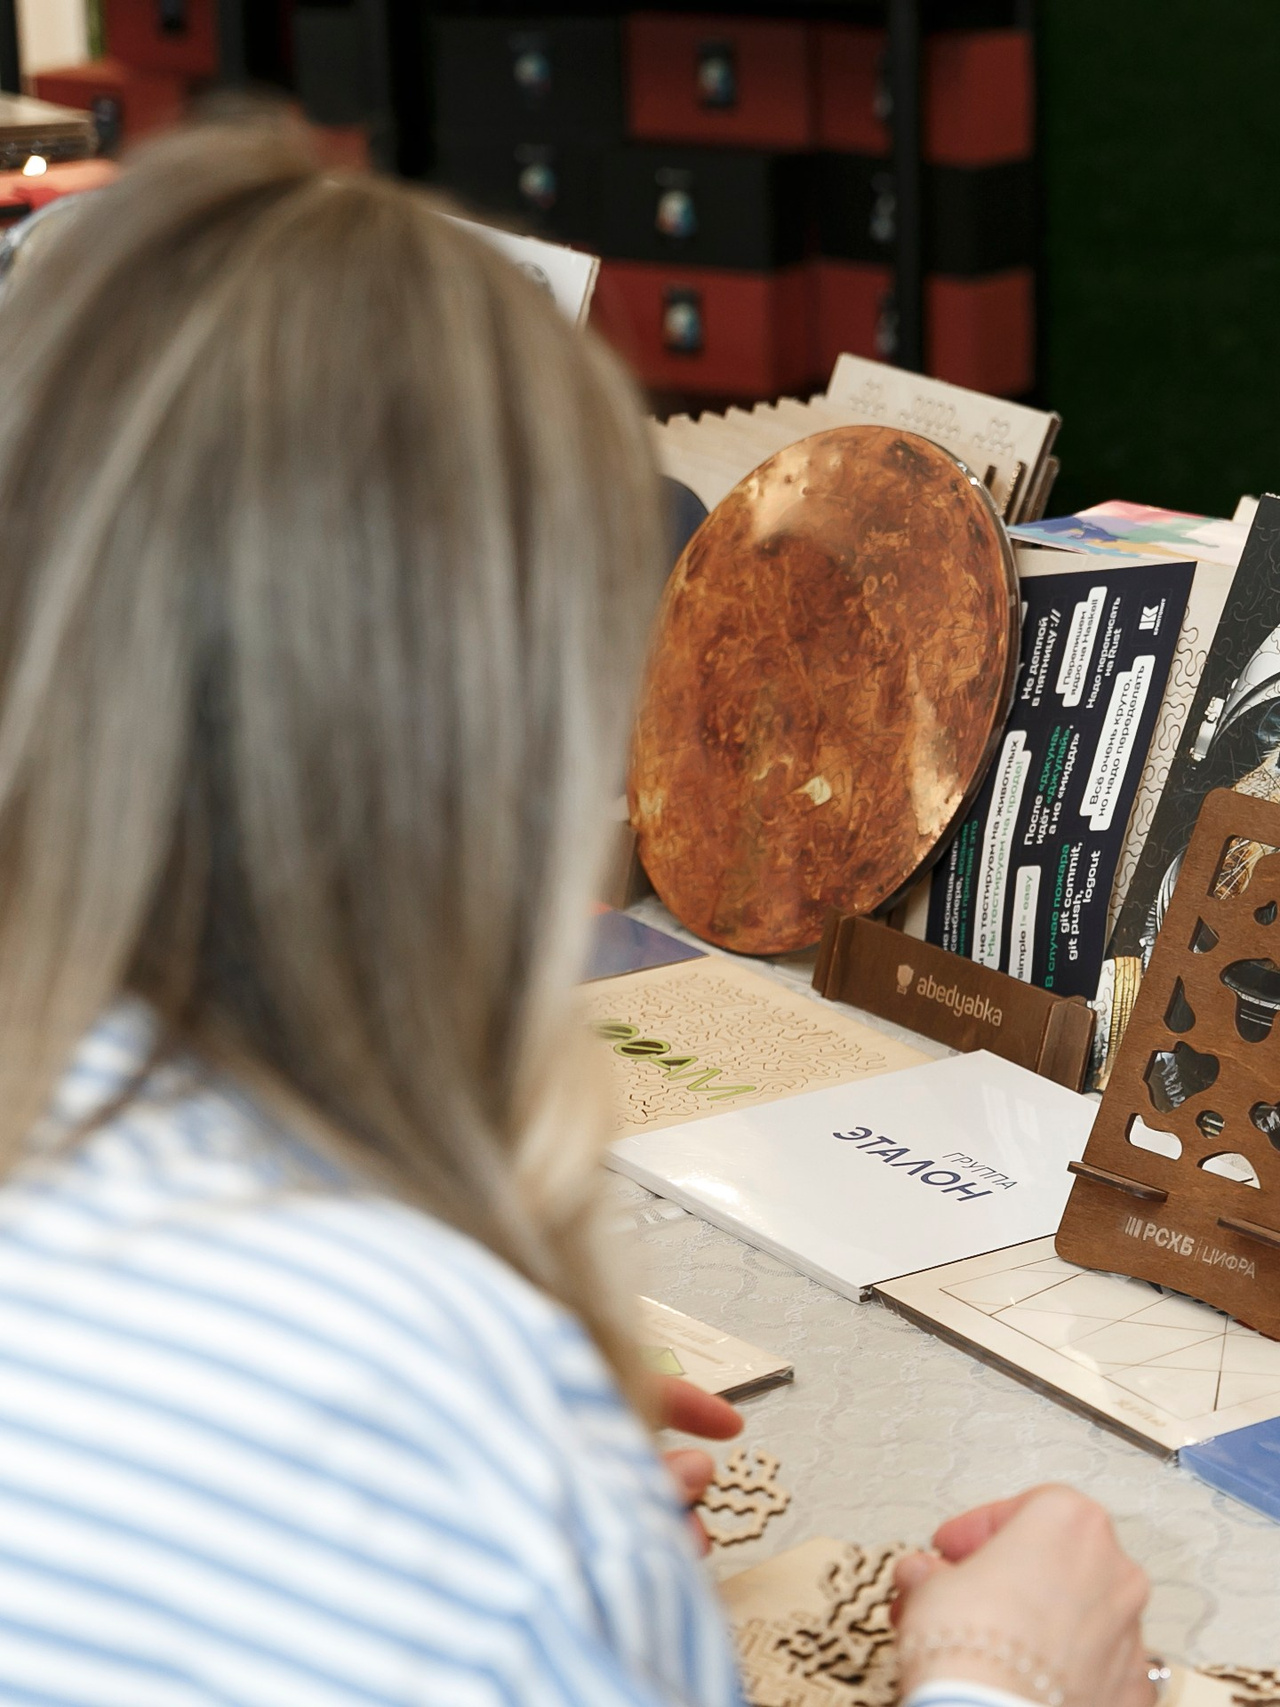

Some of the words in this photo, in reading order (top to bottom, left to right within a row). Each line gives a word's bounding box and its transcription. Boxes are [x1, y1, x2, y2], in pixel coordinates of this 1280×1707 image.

[1082, 599, 1098, 643] Haskell
[1108, 628, 1122, 658] Rust
[1021, 677, 1034, 699] Не
[1029, 617, 1048, 675] деплой
[1035, 630, 1057, 694] пятницу
[1063, 611, 1086, 685] Перепишем
[1080, 647, 1086, 661] на
[1086, 675, 1101, 708] Надо
[1097, 597, 1120, 672] переписать
[1105, 661, 1114, 676] на
[1032, 697, 1040, 706] в
[1071, 665, 1082, 695] ядро
[1058, 733, 1080, 799] «миддл»
[1089, 776, 1104, 805] Всё
[1100, 729, 1118, 773] очень
[1114, 678, 1132, 725] круто,
[1098, 800, 1108, 816] но
[1105, 757, 1120, 796] надо
[1116, 665, 1145, 754] переделать
[996, 740, 1019, 817] животных
[1007, 761, 1024, 814] проде!
[1024, 795, 1043, 845] После
[1038, 726, 1060, 791] «джуна»
[991, 821, 1000, 840] на
[1002, 818, 1010, 836] на
[1036, 807, 1050, 844] идёт
[1049, 824, 1057, 834] а
[1052, 802, 1062, 821] не
[981, 843, 996, 930] тестируем
[991, 840, 1006, 926] тестируем
[1054, 844, 1070, 908] пожара
[1064, 842, 1083, 908] commit,
[1082, 850, 1101, 903] logout
[944, 876, 955, 930] можешь
[951, 877, 964, 953] семблере,
[1017, 930, 1027, 978] simple
[1022, 875, 1033, 911] easy
[1060, 911, 1070, 934] git
[1071, 890, 1084, 935] push,
[979, 933, 987, 952] не
[987, 931, 996, 957] Мы
[1048, 911, 1059, 971] случае
[1068, 938, 1078, 961] git
[917, 975, 1002, 1027] abedyabka
[1045, 976, 1054, 988] В
[833, 1126, 993, 1201] ЭТАЛОН
[942, 1152, 1018, 1190] ГРУППА
[1142, 1222, 1195, 1256] РСХБ
[1202, 1246, 1256, 1279] ЦИФРА
